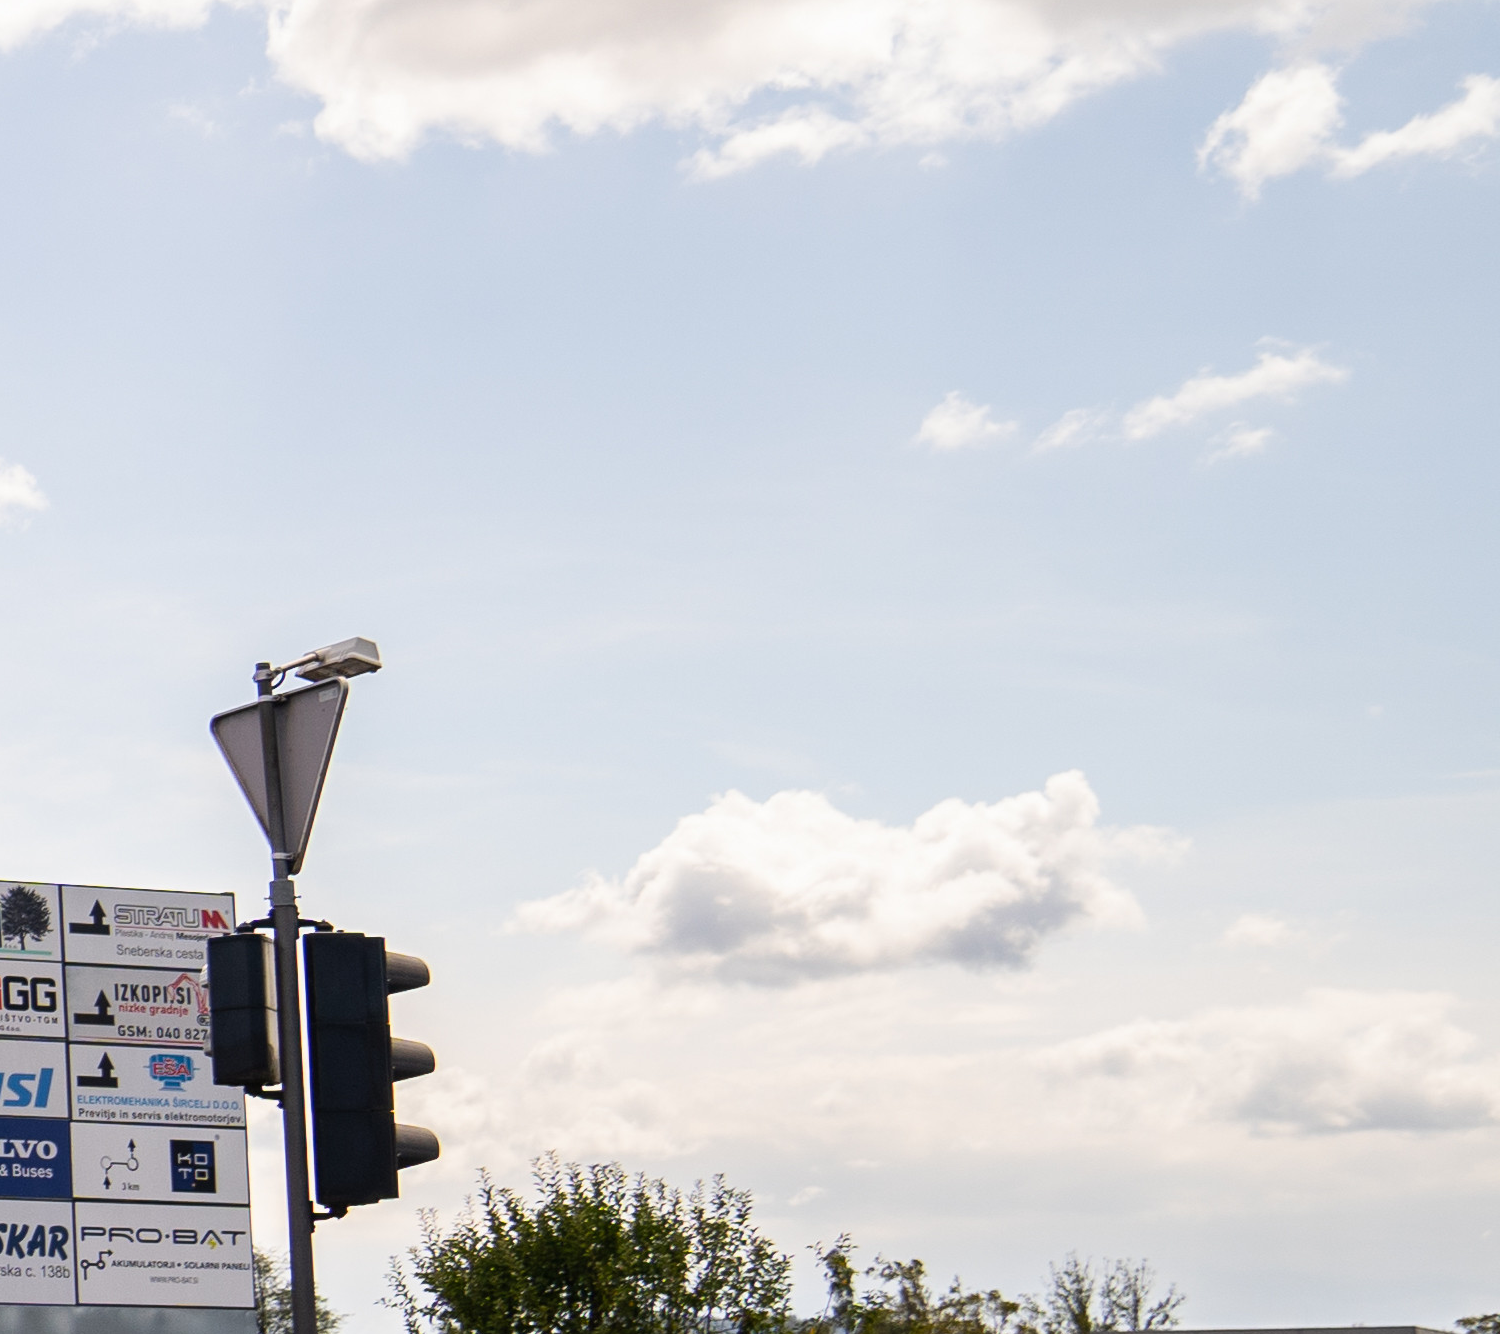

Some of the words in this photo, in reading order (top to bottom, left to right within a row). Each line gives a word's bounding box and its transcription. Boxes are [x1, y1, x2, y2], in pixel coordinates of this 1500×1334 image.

[113, 903, 229, 930] STRATUM
[116, 944, 172, 958] Sneberska
[175, 947, 204, 960] cesta
[114, 983, 192, 1005] IZKOPI.SI
[118, 1003, 146, 1014] nizke
[149, 1003, 189, 1017] gradnje
[117, 1025, 152, 1038] GSM:
[156, 1027, 180, 1039] 040
[184, 1028, 209, 1041] 827
[77, 1094, 170, 1108] ELEKTROMEHANIKA
[172, 1095, 211, 1109] ŠIRCELJ
[212, 1101, 242, 1111] D.O.O.
[78, 1108, 117, 1121] Previtje
[119, 1109, 129, 1118] in
[131, 1111, 161, 1120] servis
[11, 1164, 54, 1178] Buses
[127, 1182, 140, 1191] km
[25, 1267, 36, 1277] c.
[41, 1265, 71, 1279] 138b
[111, 1260, 176, 1270] AKUMULATORJI
[183, 1261, 220, 1270] SOLARNI
